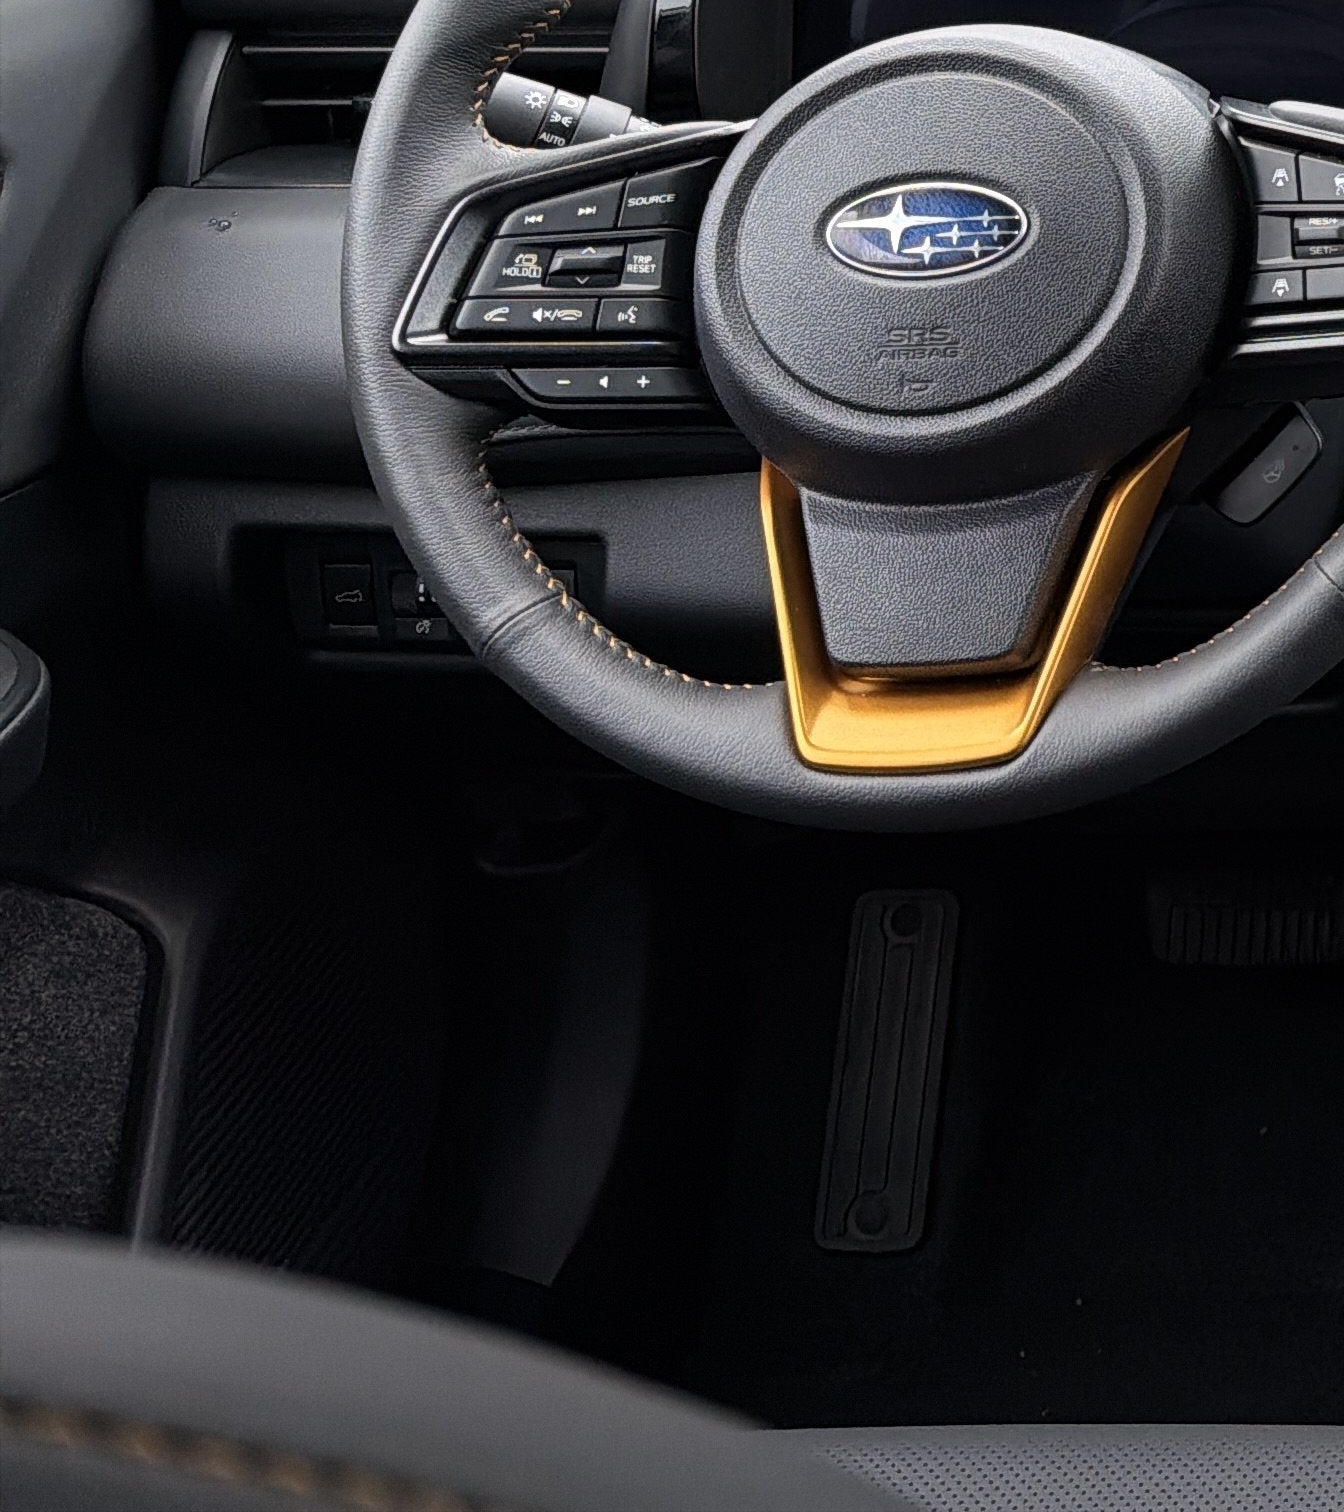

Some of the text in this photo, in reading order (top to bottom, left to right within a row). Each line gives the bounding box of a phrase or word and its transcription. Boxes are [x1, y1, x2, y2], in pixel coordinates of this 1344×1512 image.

[538, 131, 566, 146] AUTO
[627, 193, 676, 208] SOURCE
[633, 255, 653, 264] TRIP
[627, 264, 656, 274] RESET
